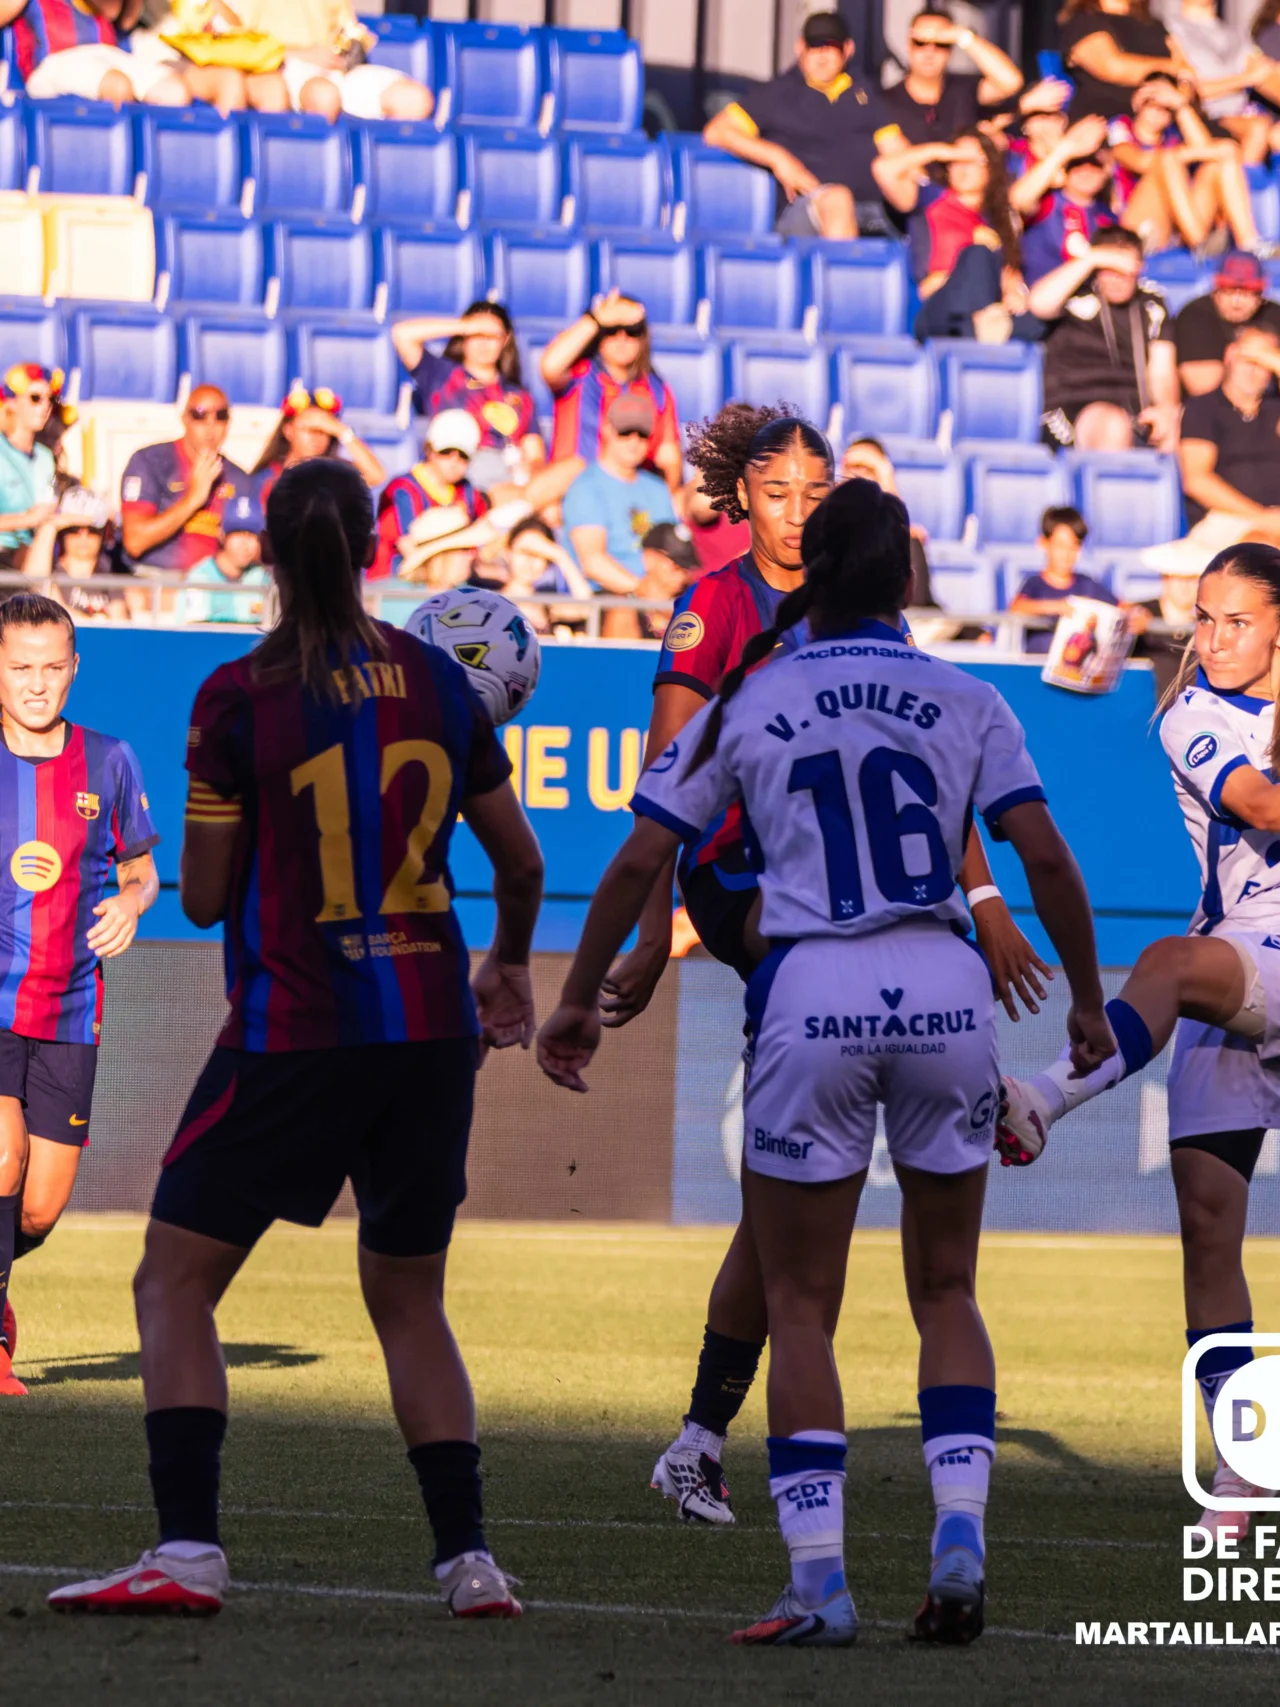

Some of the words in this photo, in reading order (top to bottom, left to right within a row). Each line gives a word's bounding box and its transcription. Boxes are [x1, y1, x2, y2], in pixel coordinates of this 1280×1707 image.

[764, 712, 811, 743] V.
[815, 683, 942, 730] QUILES
[290, 739, 453, 922] 12
[787, 746, 955, 922] 16
[840, 1044, 864, 1057] POR
[867, 1043, 881, 1056] LA
[884, 1042, 946, 1055] IGUALDAD
[754, 1127, 814, 1160] Binter
[938, 1454, 971, 1467] FEM
[786, 1480, 832, 1502] CDT
[796, 1495, 830, 1512] FEM
